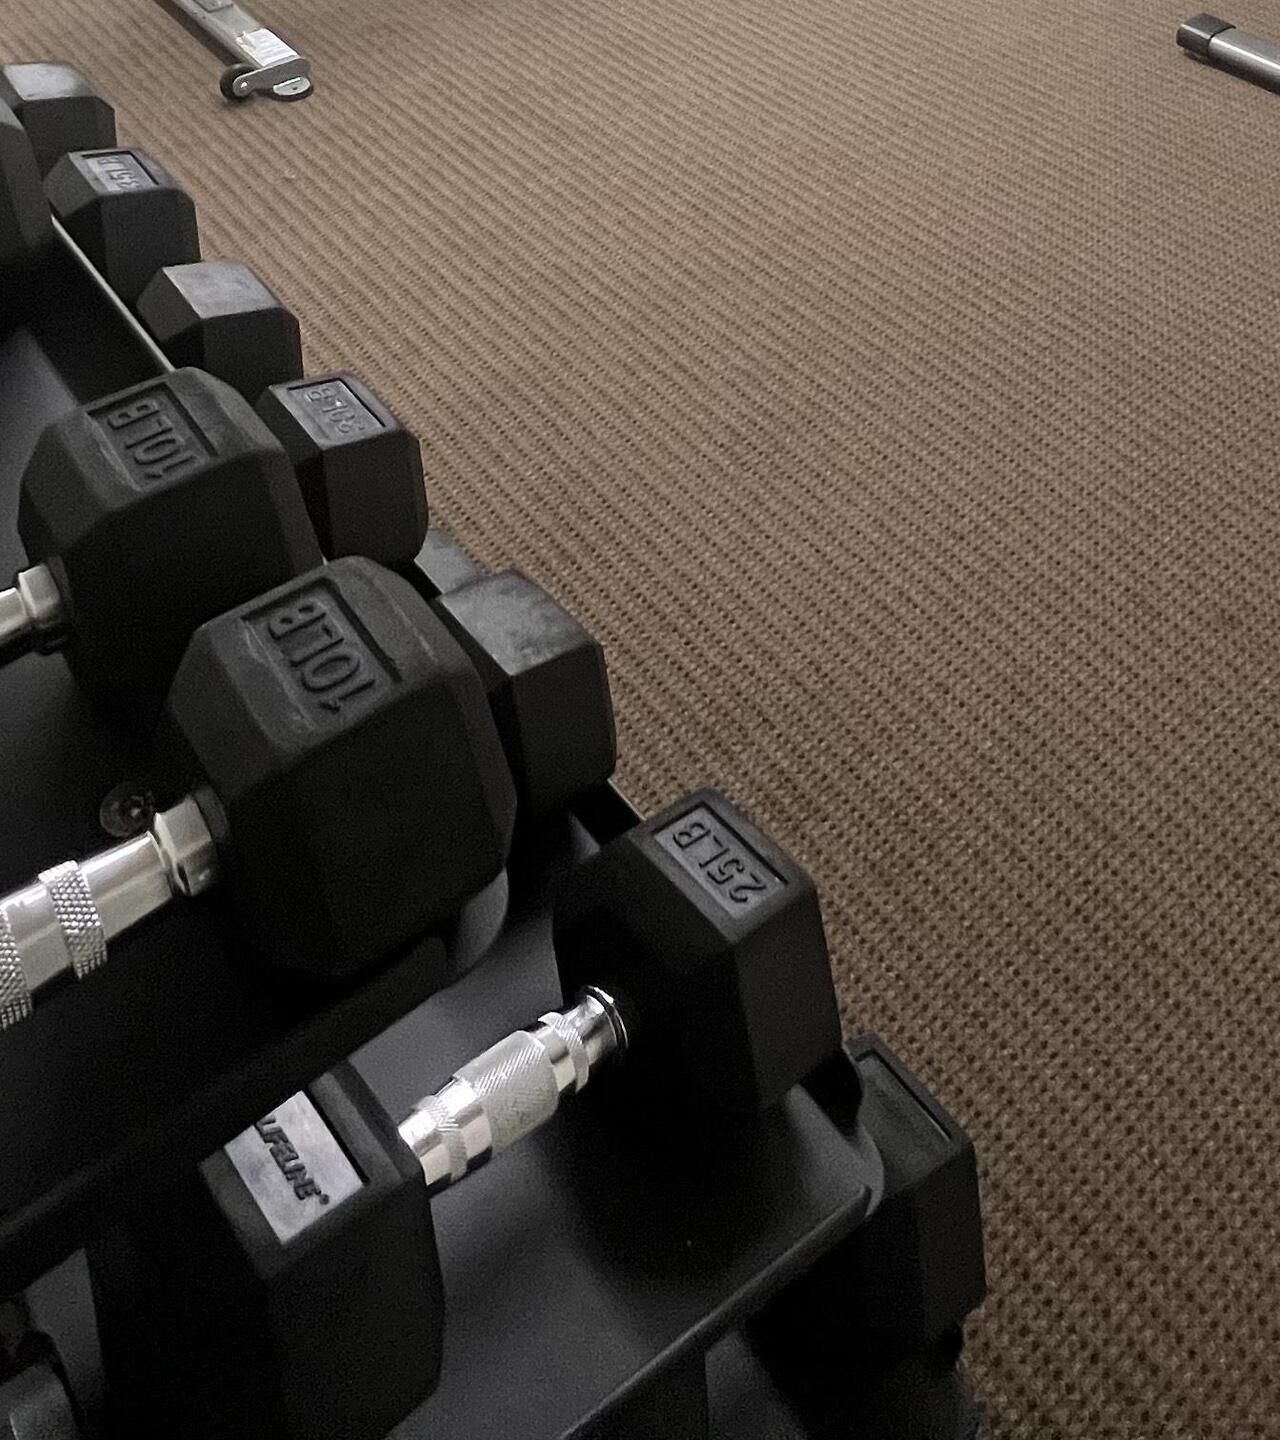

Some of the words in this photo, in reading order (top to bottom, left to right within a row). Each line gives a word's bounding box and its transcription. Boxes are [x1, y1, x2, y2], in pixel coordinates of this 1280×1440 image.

[106, 397, 202, 479] 10LB
[267, 596, 378, 714] 10LB
[672, 821, 767, 903] 25LB
